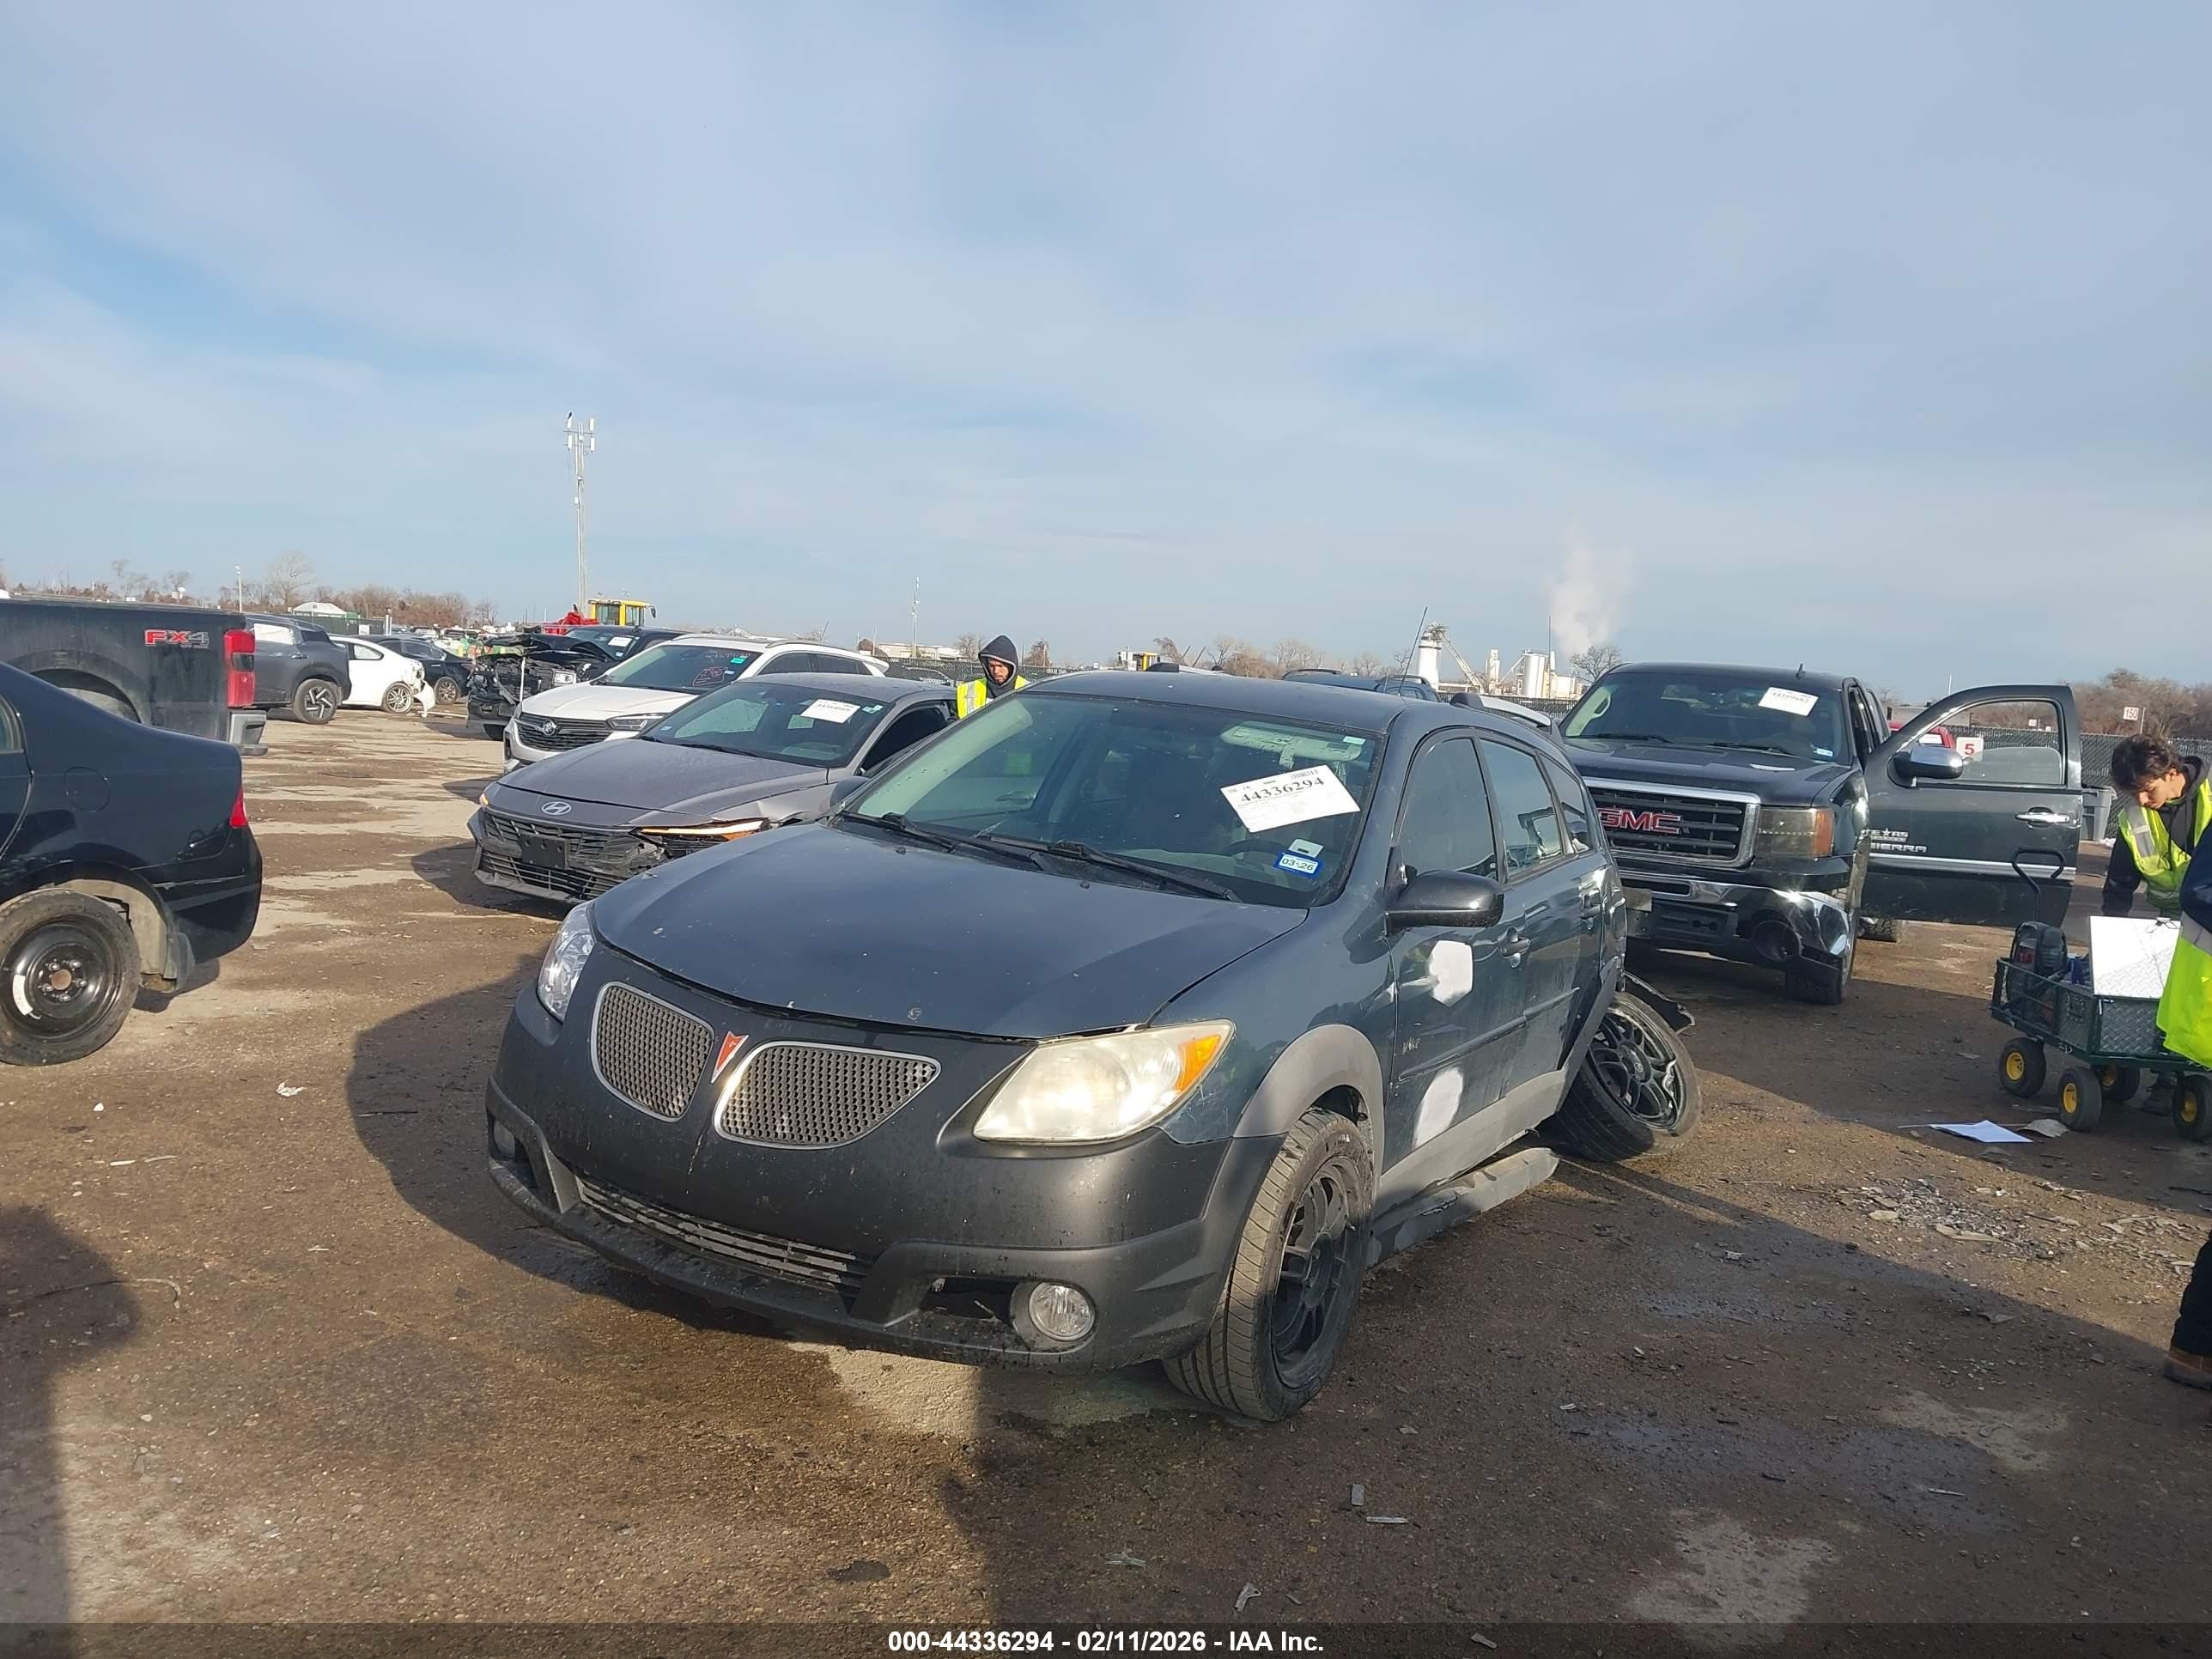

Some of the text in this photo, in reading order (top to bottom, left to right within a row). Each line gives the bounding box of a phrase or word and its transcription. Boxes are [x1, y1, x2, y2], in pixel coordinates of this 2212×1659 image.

[144, 629, 209, 646] FX4
[2125, 708, 2138, 719] 150
[1964, 743, 1975, 756] 5
[1240, 776, 1325, 802] 44336294
[1596, 807, 1681, 836] GMC
[1867, 827, 1909, 838] EXAS
